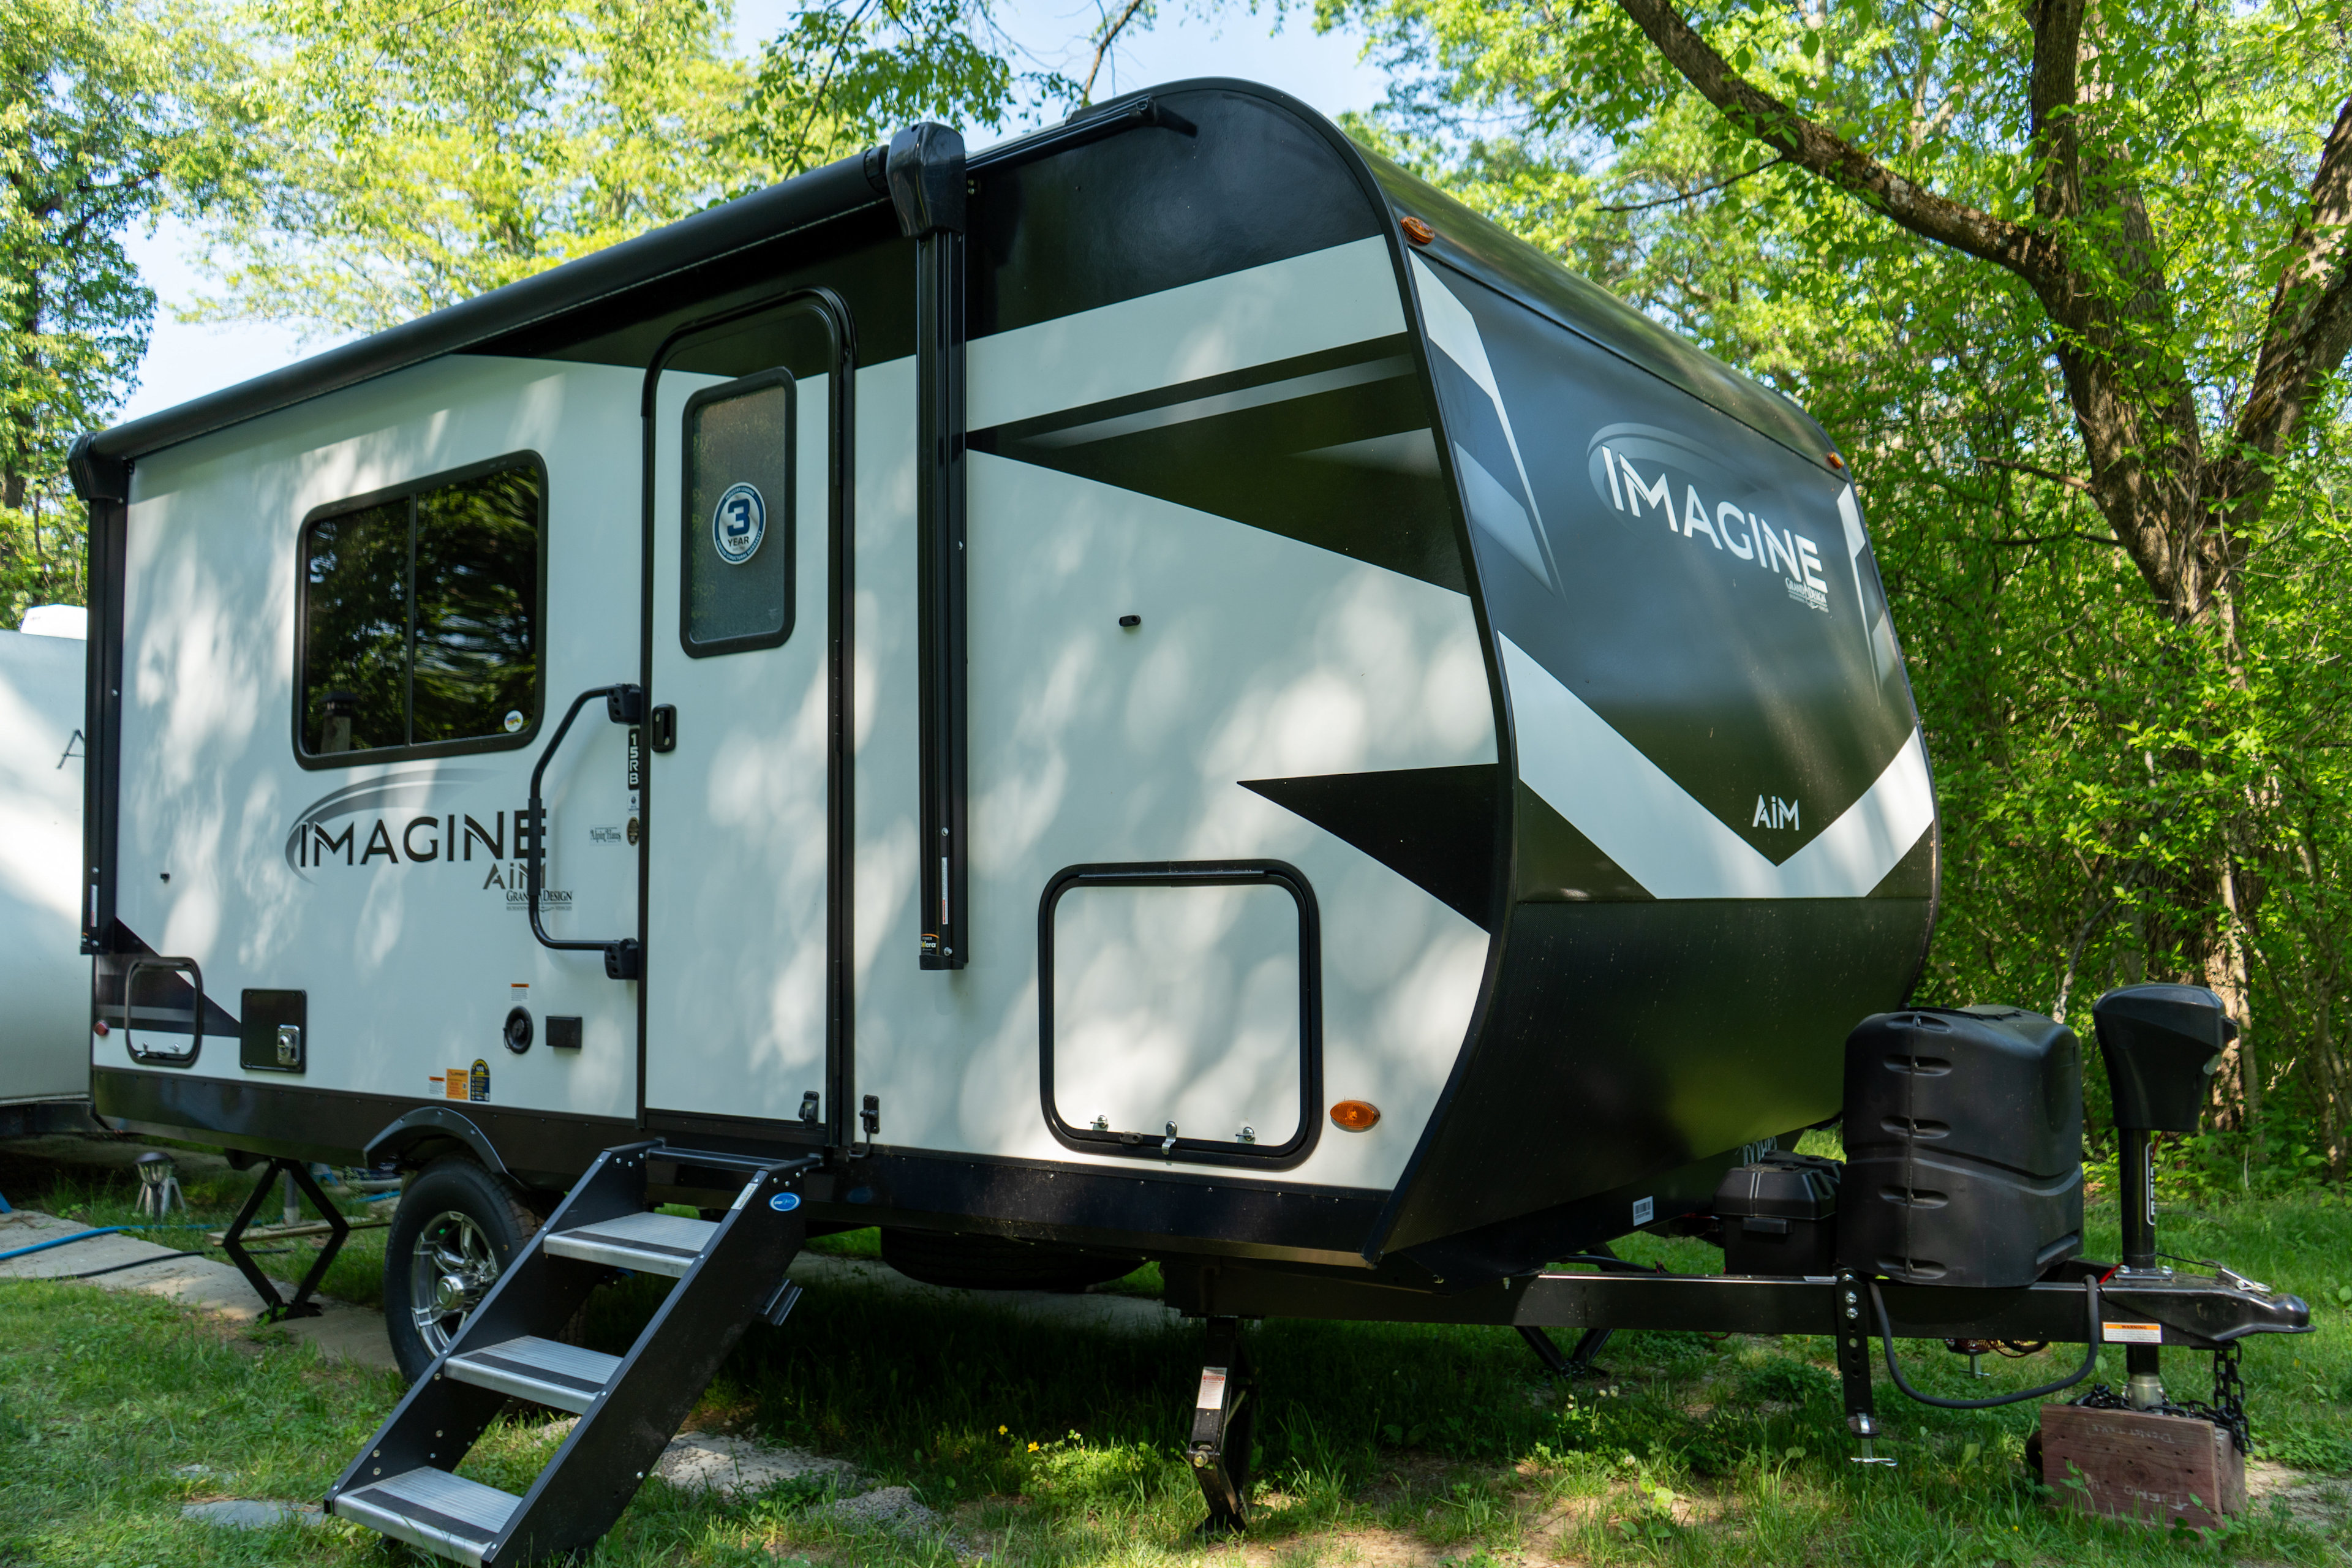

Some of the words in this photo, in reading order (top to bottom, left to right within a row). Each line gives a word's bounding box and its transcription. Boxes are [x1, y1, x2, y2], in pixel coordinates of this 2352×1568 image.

[727, 498, 750, 537] 3
[1601, 445, 1828, 594] IMAGINE
[728, 536, 750, 548] YEAR
[629, 733, 639, 786] 15RB
[300, 809, 546, 867] IMAGINE
[506, 889, 530, 902] GRAN
[543, 890, 573, 902] DESIGN
